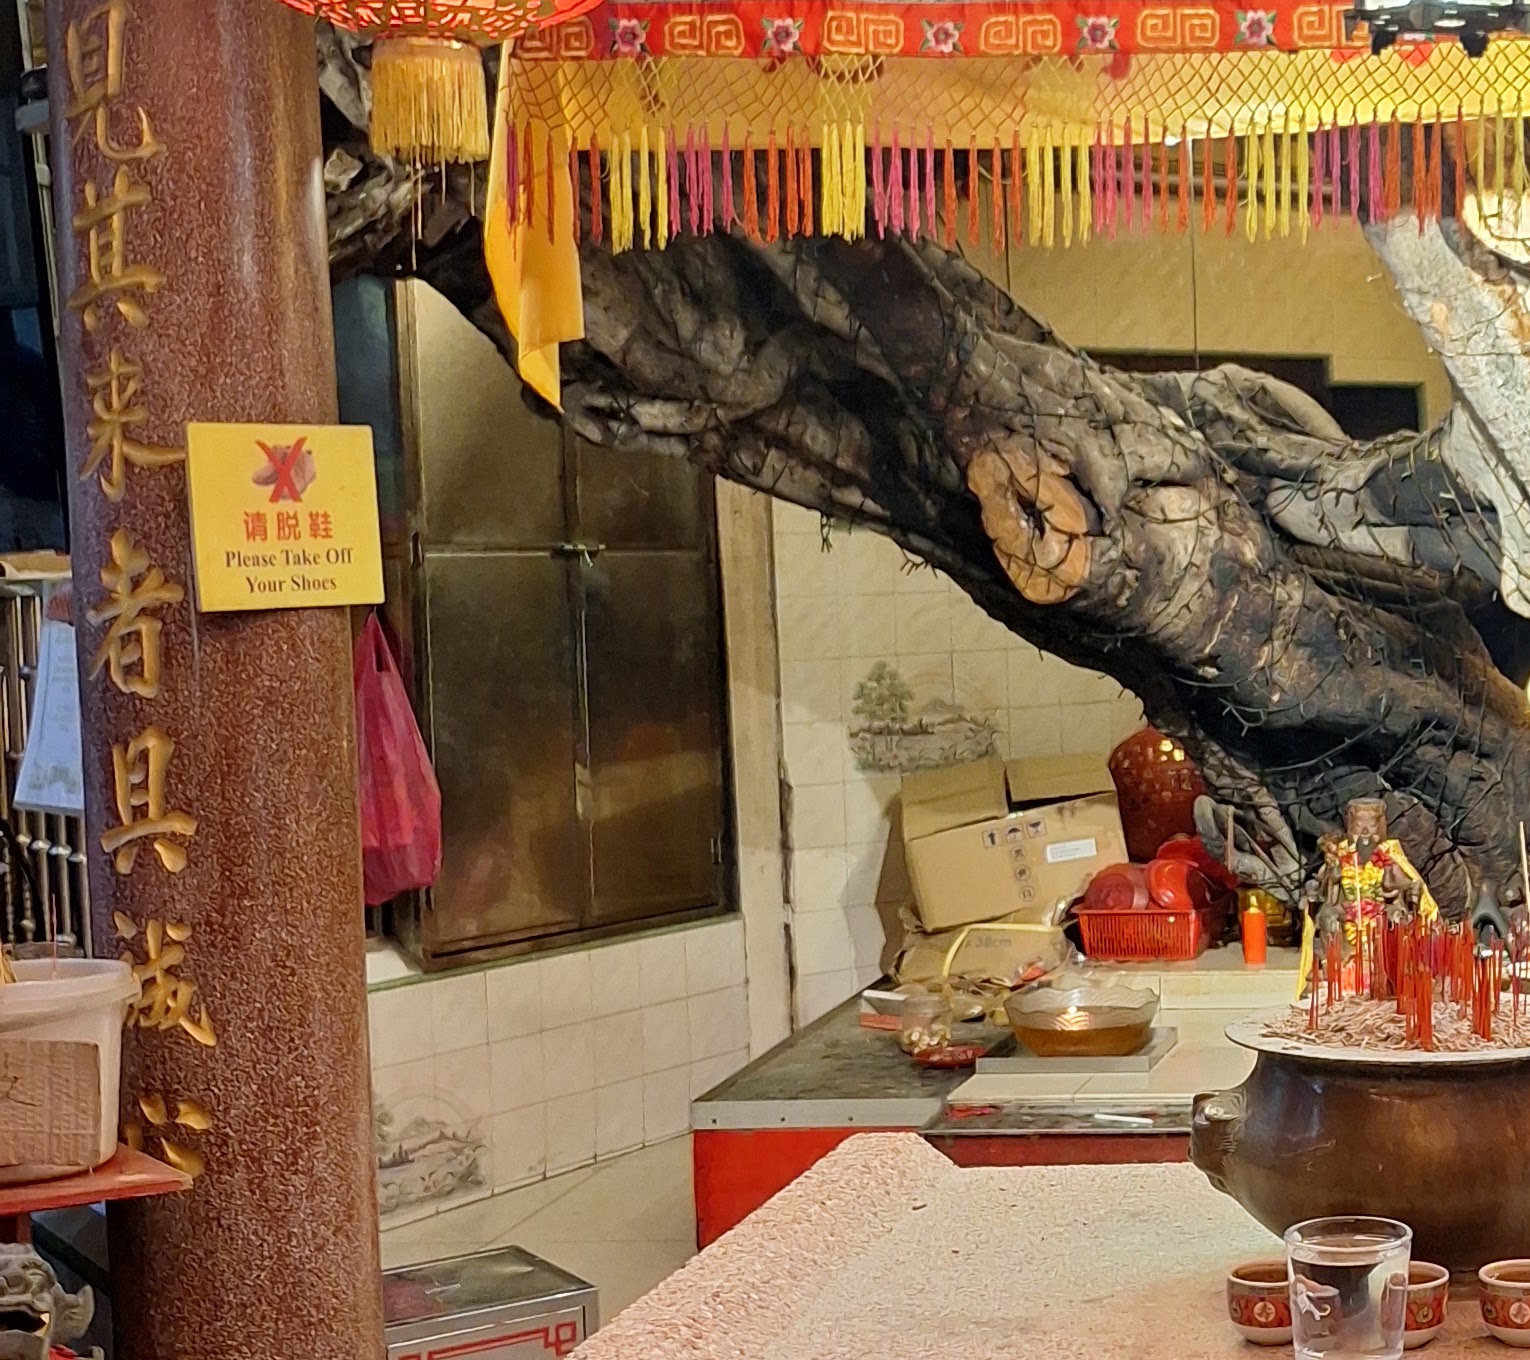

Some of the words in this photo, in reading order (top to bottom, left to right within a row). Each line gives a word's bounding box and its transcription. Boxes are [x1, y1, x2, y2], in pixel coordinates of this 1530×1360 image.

[243, 510, 335, 543] 请脱鞋
[225, 549, 277, 569] Please
[280, 548, 322, 566] Take
[326, 546, 355, 565] Off
[245, 575, 287, 594] Your
[290, 574, 338, 592] Shoes
